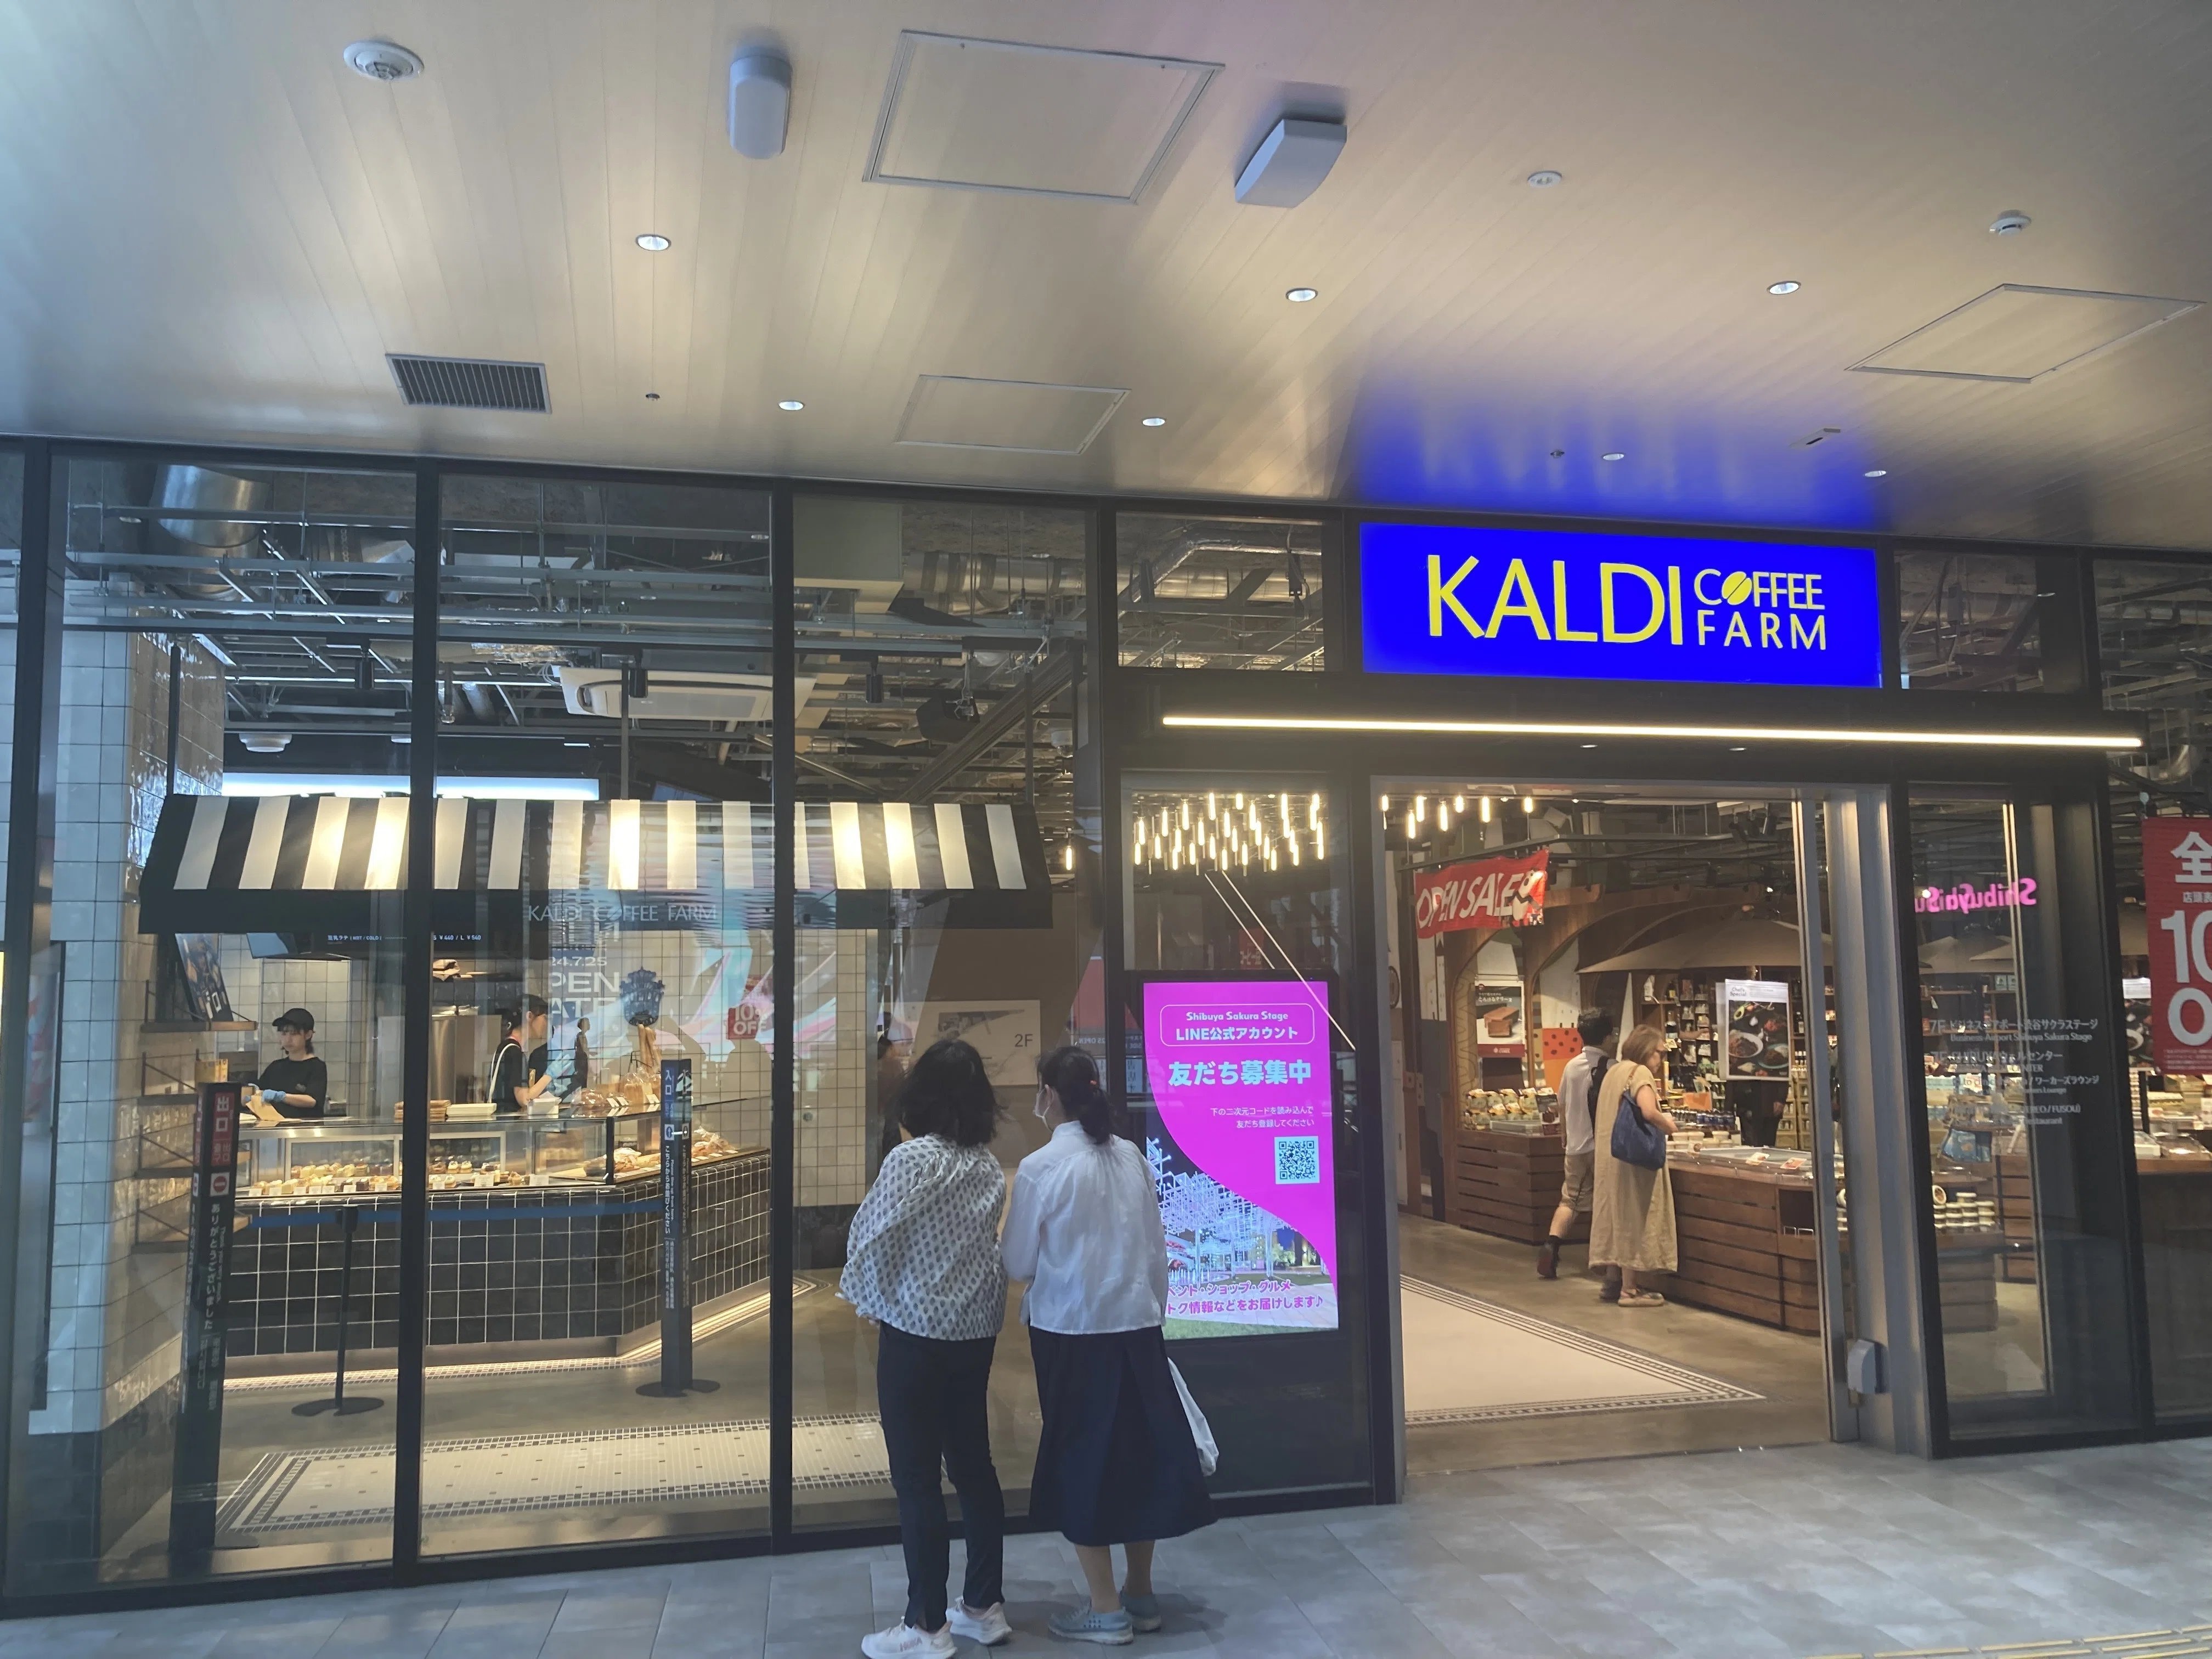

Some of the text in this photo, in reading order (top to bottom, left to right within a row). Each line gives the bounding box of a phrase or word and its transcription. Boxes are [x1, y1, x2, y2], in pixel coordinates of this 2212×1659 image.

[1426, 554, 1825, 645] KALDI COFFEE
[1697, 610, 1826, 650] FARM
[1416, 872, 1525, 929] OPEN SALE
[528, 905, 716, 922] KALDI COFFEE FARM
[1186, 1011, 1289, 1022] Shibuya Sakura Stage
[1014, 1034, 1033, 1047] 2F
[1176, 1026, 1298, 1041] LINE公式アカウント
[665, 1069, 672, 1096] 入口
[1167, 1059, 1312, 1087] 友だち募集中
[216, 1095, 229, 1132] 出口
[1210, 1105, 1314, 1117] 下の二次元コードを読み込んで
[1236, 1119, 1314, 1128] 友だち登録してください
